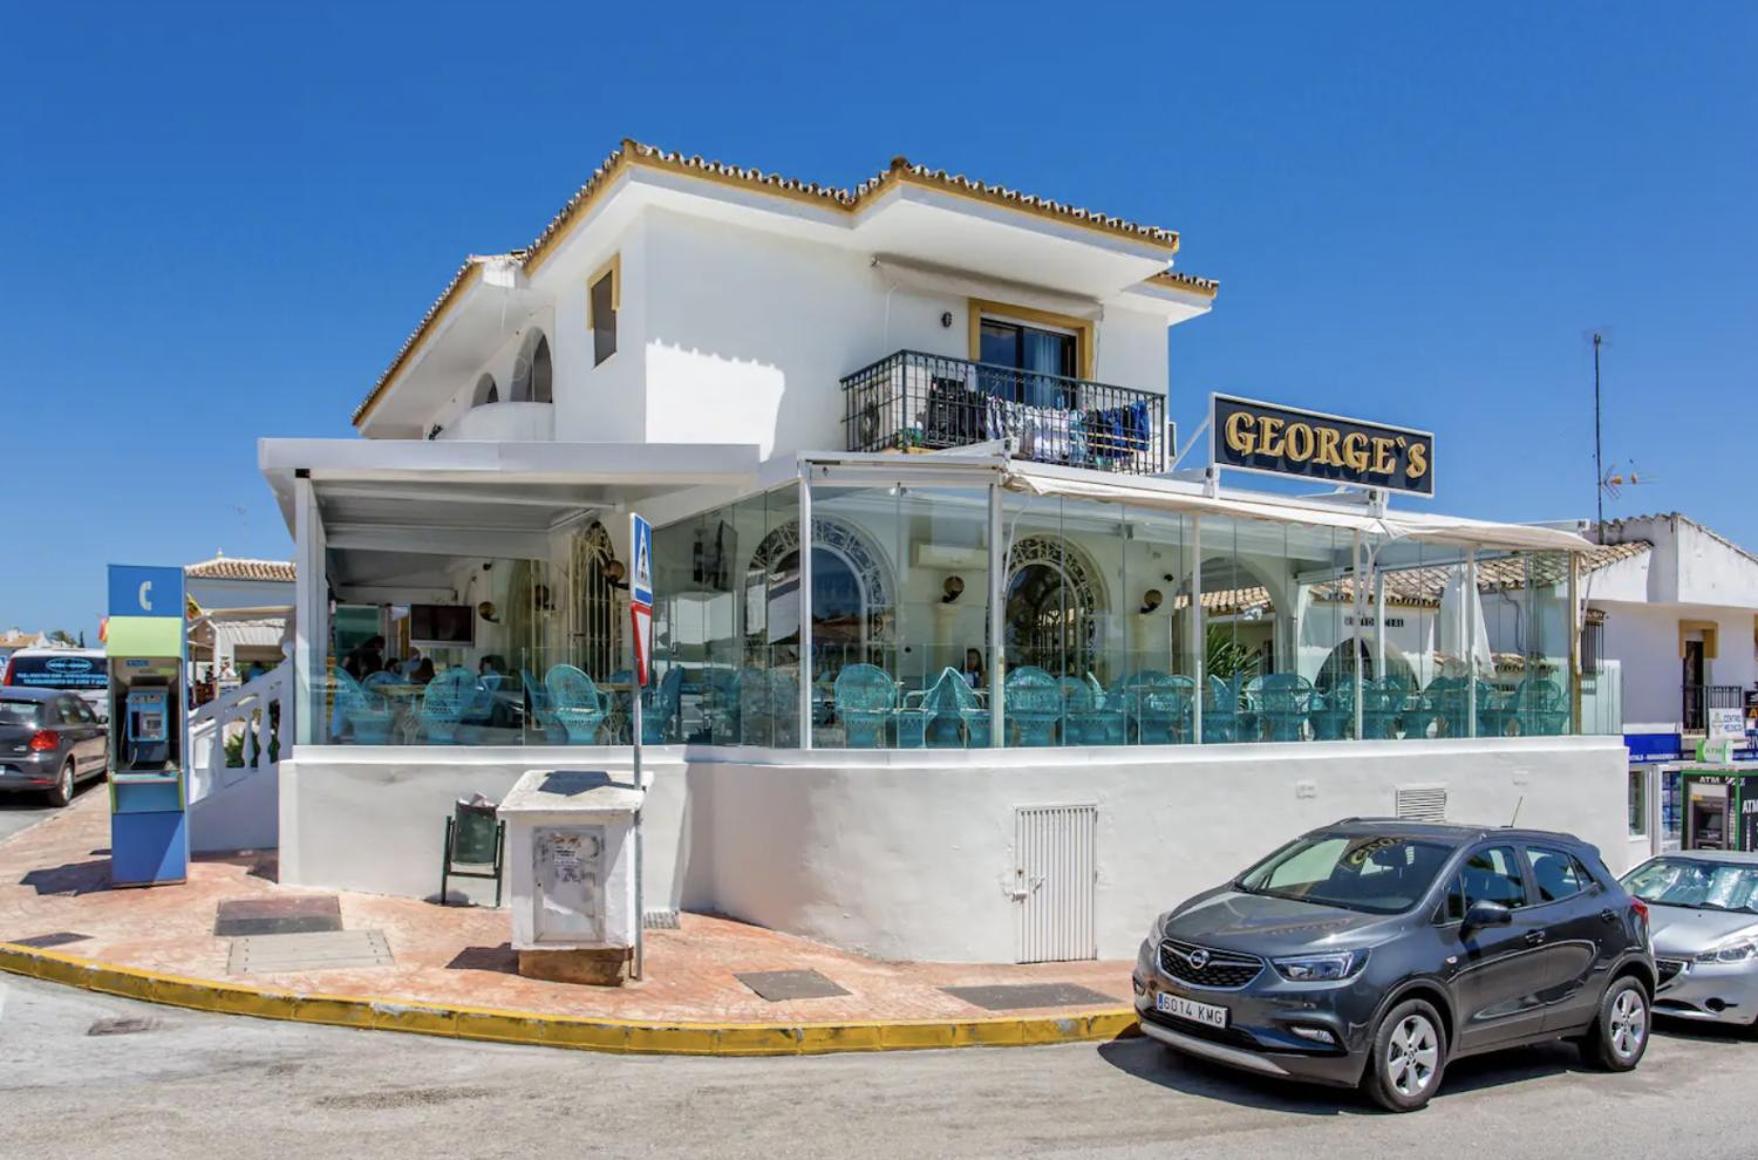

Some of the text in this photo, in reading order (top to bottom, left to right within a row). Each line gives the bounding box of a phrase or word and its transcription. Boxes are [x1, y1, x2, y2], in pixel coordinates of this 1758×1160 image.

[1699, 776, 1720, 784] ATM
[1163, 996, 1223, 1024] 6014 KMG
